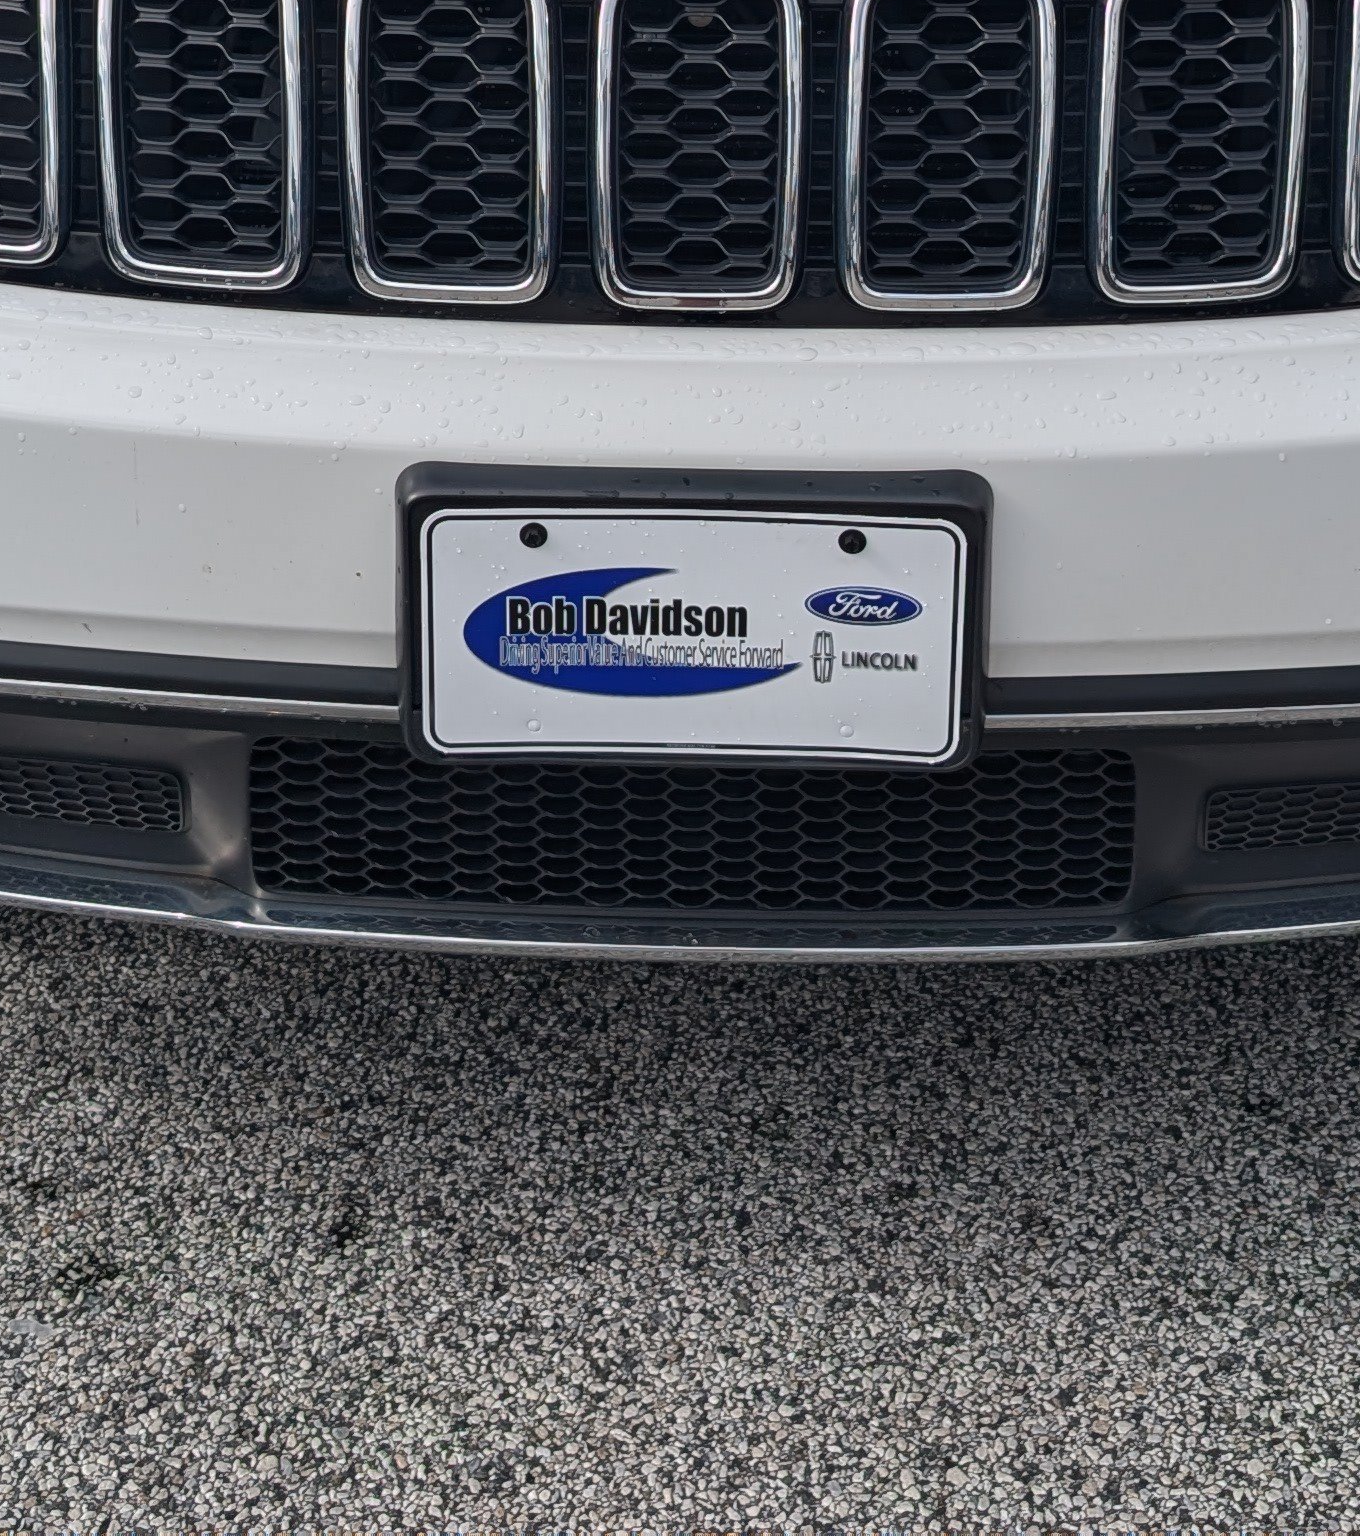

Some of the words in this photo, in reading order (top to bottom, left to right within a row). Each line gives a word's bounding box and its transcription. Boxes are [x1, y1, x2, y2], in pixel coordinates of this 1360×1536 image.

[506, 596, 578, 637] Bob
[583, 596, 748, 638] Davidson
[828, 591, 899, 620] Ford
[499, 635, 540, 674] Driving
[540, 635, 587, 674] Superior
[587, 635, 619, 666] Value
[620, 635, 643, 667] And
[644, 636, 697, 667] Customer
[698, 637, 738, 668] Service
[739, 639, 784, 669] Forward
[841, 650, 918, 671] LINCOLN
